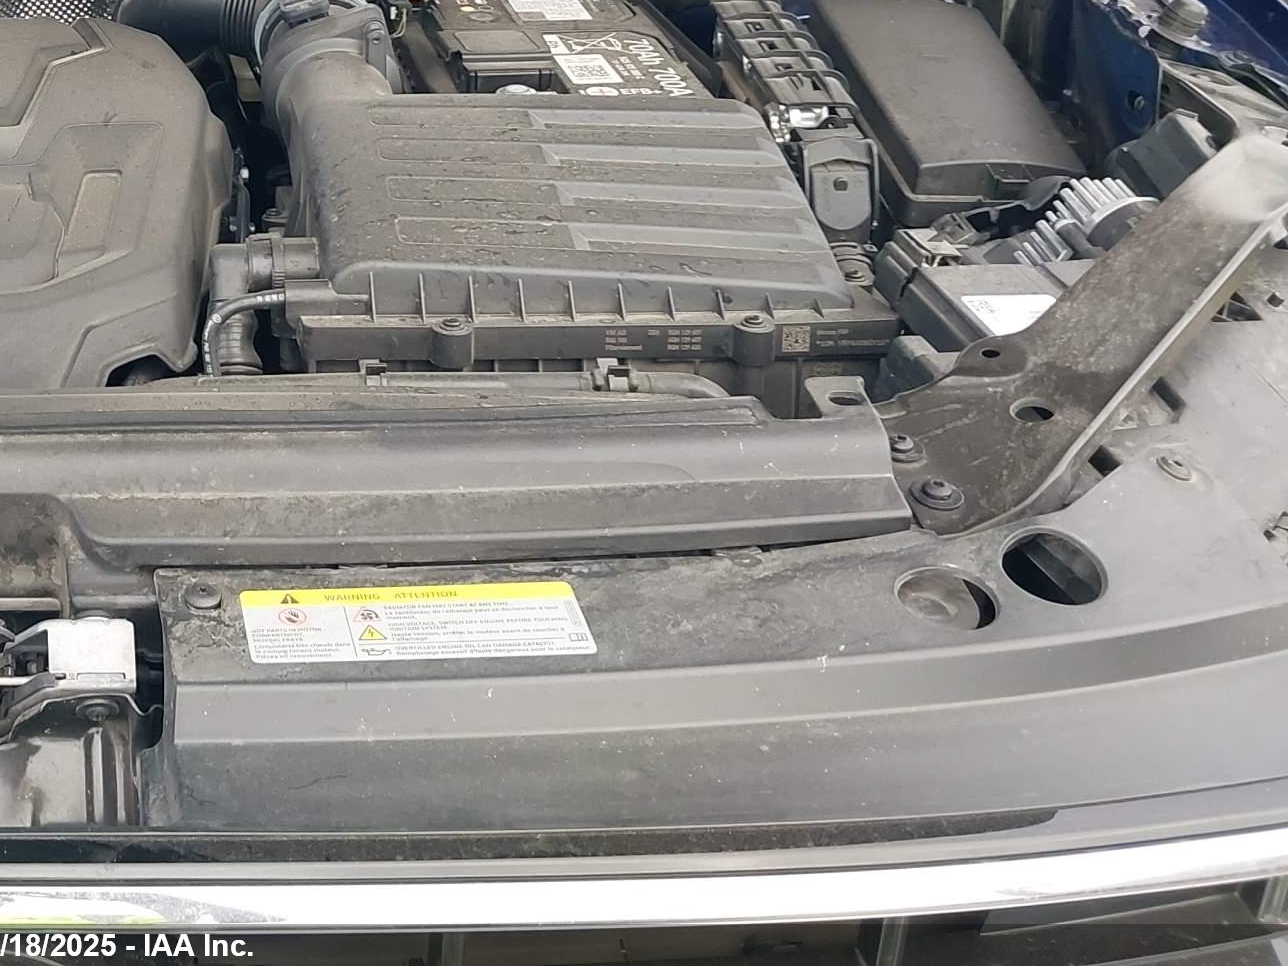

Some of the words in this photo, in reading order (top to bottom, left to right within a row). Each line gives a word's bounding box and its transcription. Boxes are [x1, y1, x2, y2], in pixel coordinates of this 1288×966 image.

[623, 39, 664, 65] 70Ah
[648, 67, 694, 97] 700A
[324, 593, 380, 601] WARNING
[392, 590, 458, 599] ATTENTION
